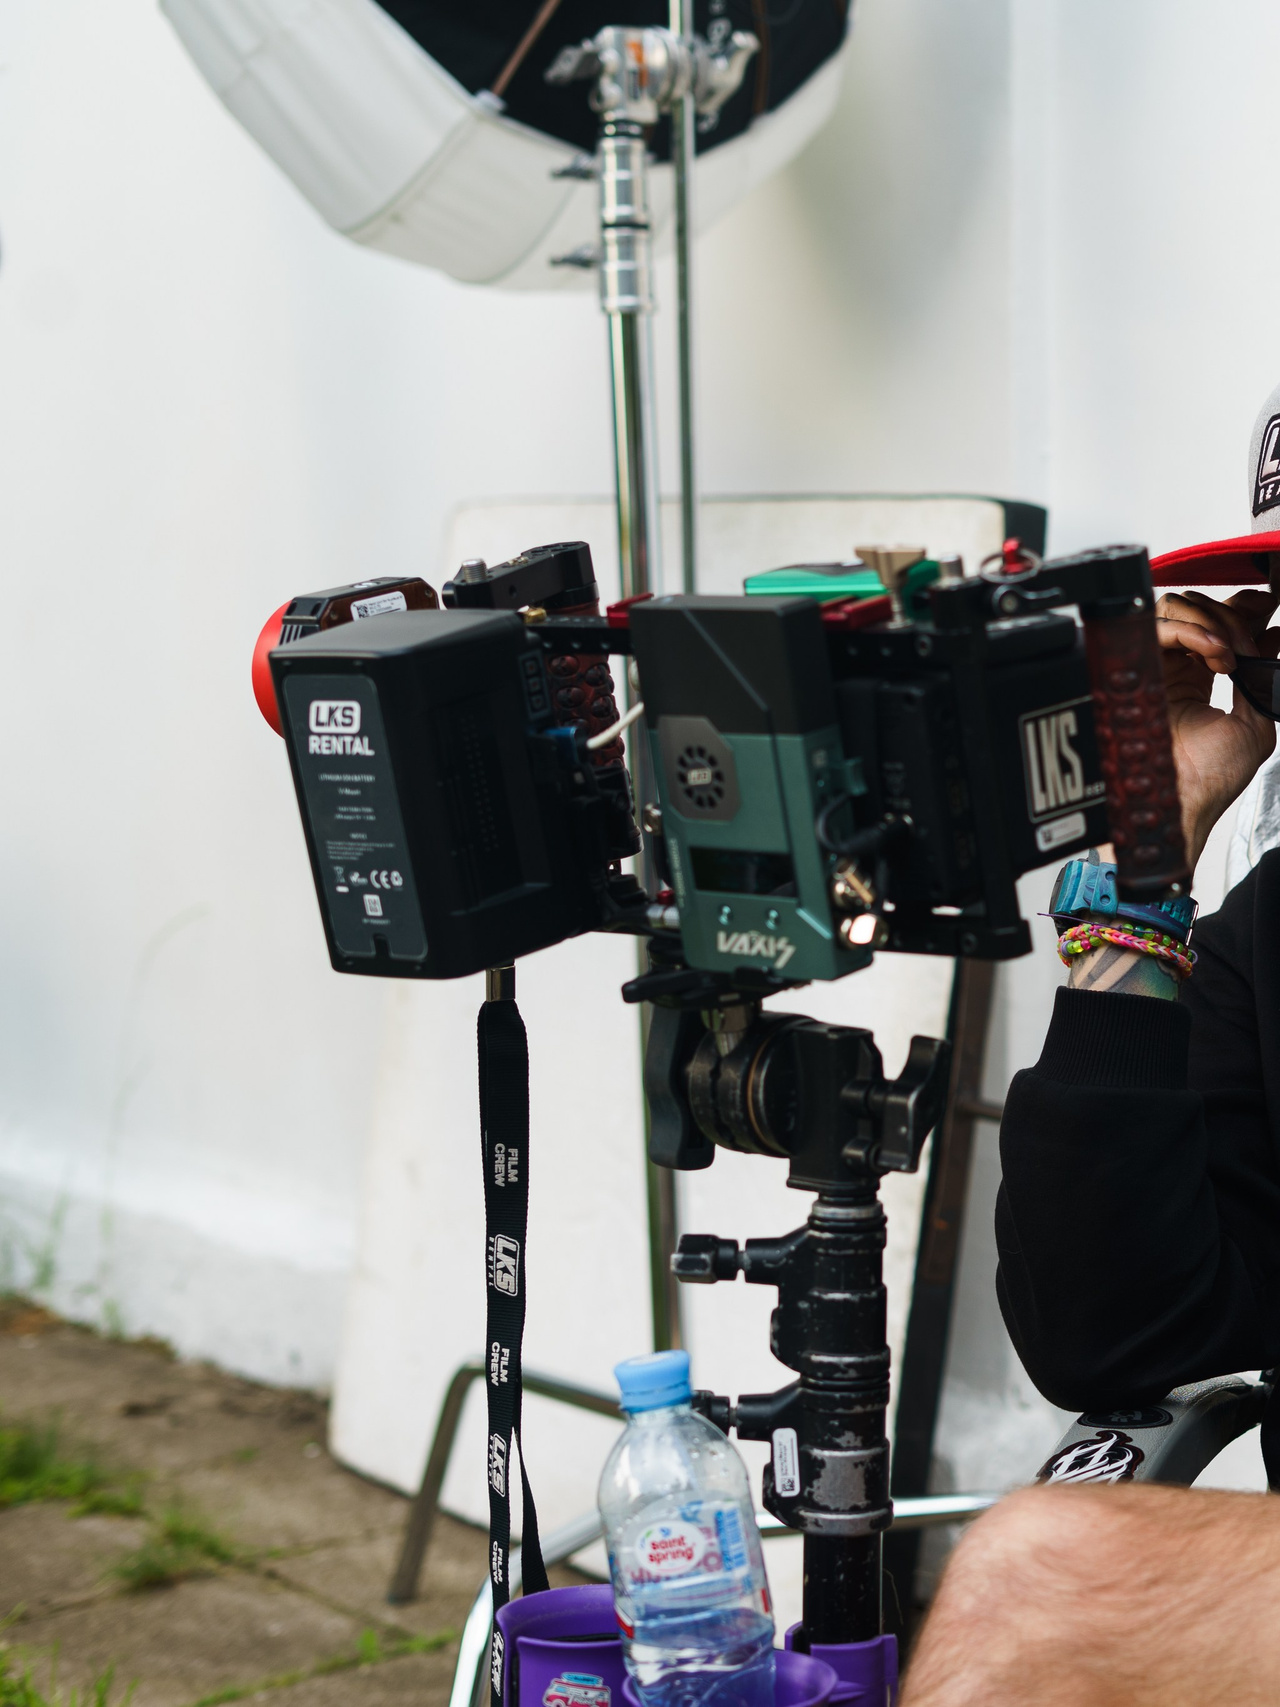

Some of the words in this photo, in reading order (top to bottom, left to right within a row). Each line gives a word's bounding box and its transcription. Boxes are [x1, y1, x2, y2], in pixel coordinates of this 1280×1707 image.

[314, 705, 355, 728] LKS
[308, 735, 376, 756] RENTAL
[1025, 710, 1085, 813] LKS
[716, 930, 798, 970] VAXIS
[494, 1143, 506, 1187] CREW
[507, 1148, 519, 1182] FILM
[495, 1237, 517, 1293] LKS
[491, 1341, 501, 1387] CREW
[499, 1347, 510, 1383] FILM
[492, 1438, 505, 1493] LKS
[648, 1547, 694, 1564] spring
[651, 1535, 686, 1550] saint
